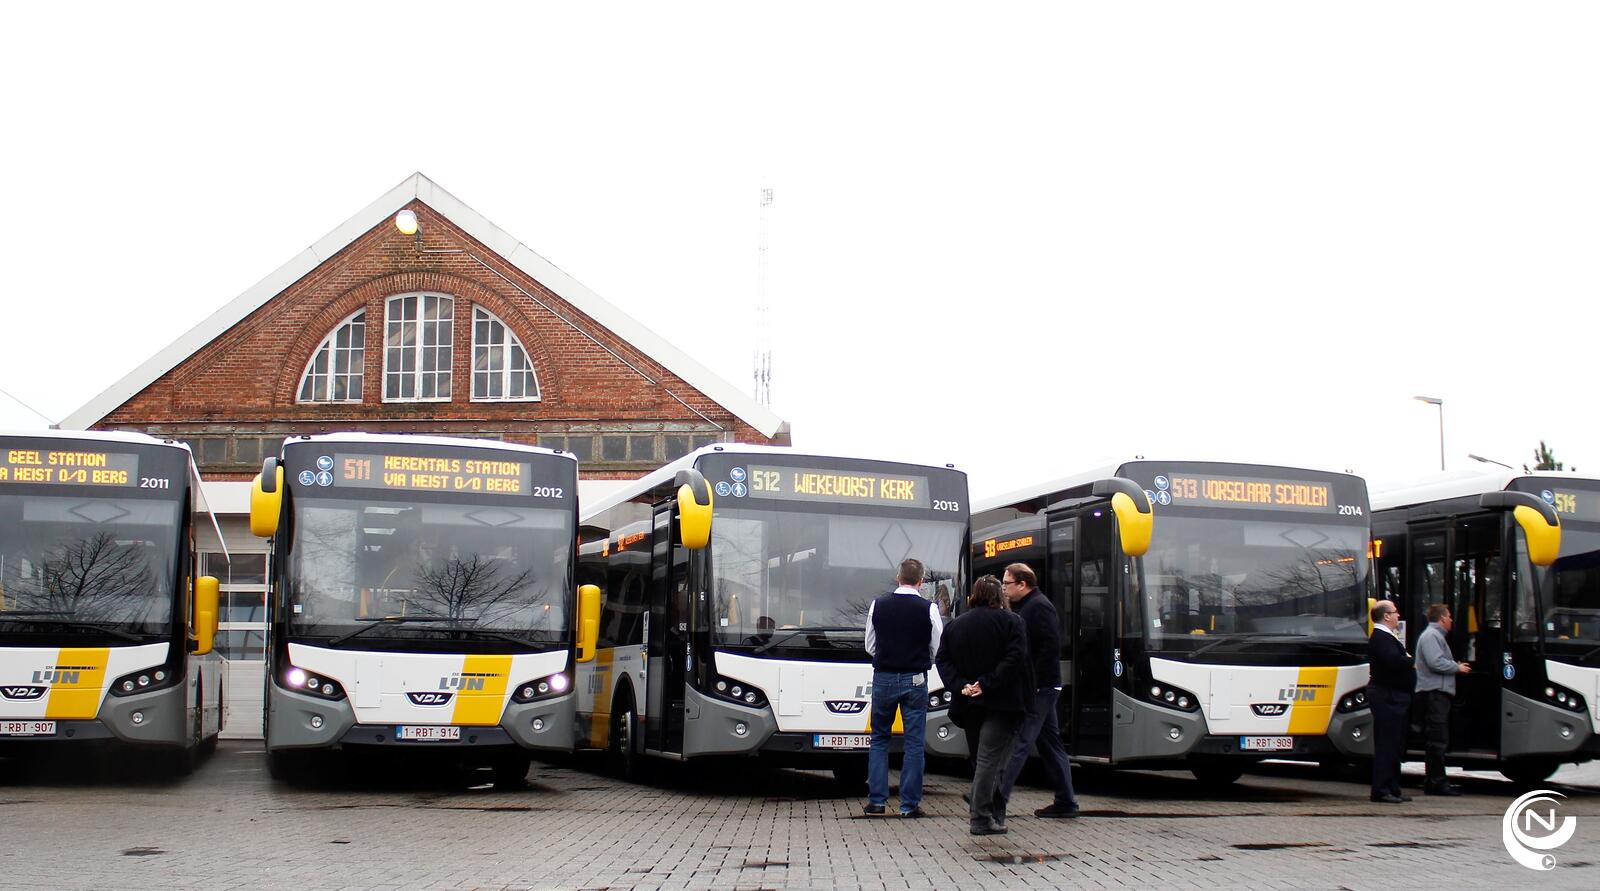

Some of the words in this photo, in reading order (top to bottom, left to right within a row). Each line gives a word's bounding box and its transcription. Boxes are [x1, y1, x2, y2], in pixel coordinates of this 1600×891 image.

[9, 450, 42, 464] GEEL
[48, 452, 106, 467] STATION
[343, 458, 370, 480] 511
[384, 456, 460, 473] HERENTALS
[465, 460, 520, 476] STATION
[14, 467, 53, 482] HEIST
[92, 470, 127, 484] BERG
[384, 472, 406, 487] VIA
[411, 474, 448, 489] HEIST
[486, 477, 520, 492] BERG
[140, 478, 169, 489] 2011
[752, 470, 781, 492] 512
[794, 473, 876, 498] WIEKEVORST
[880, 478, 914, 500] KERK
[533, 486, 563, 499] 2012
[1172, 478, 1198, 498] 513
[1202, 479, 1272, 504] VORSELAAR
[1275, 485, 1328, 507] SCHOLEN
[933, 500, 959, 512] 2013
[1338, 504, 1363, 517] 2014
[5, 687, 39, 697] VDL
[413, 694, 446, 703] VDL
[831, 702, 861, 711] VDL
[1256, 705, 1284, 714] VDL
